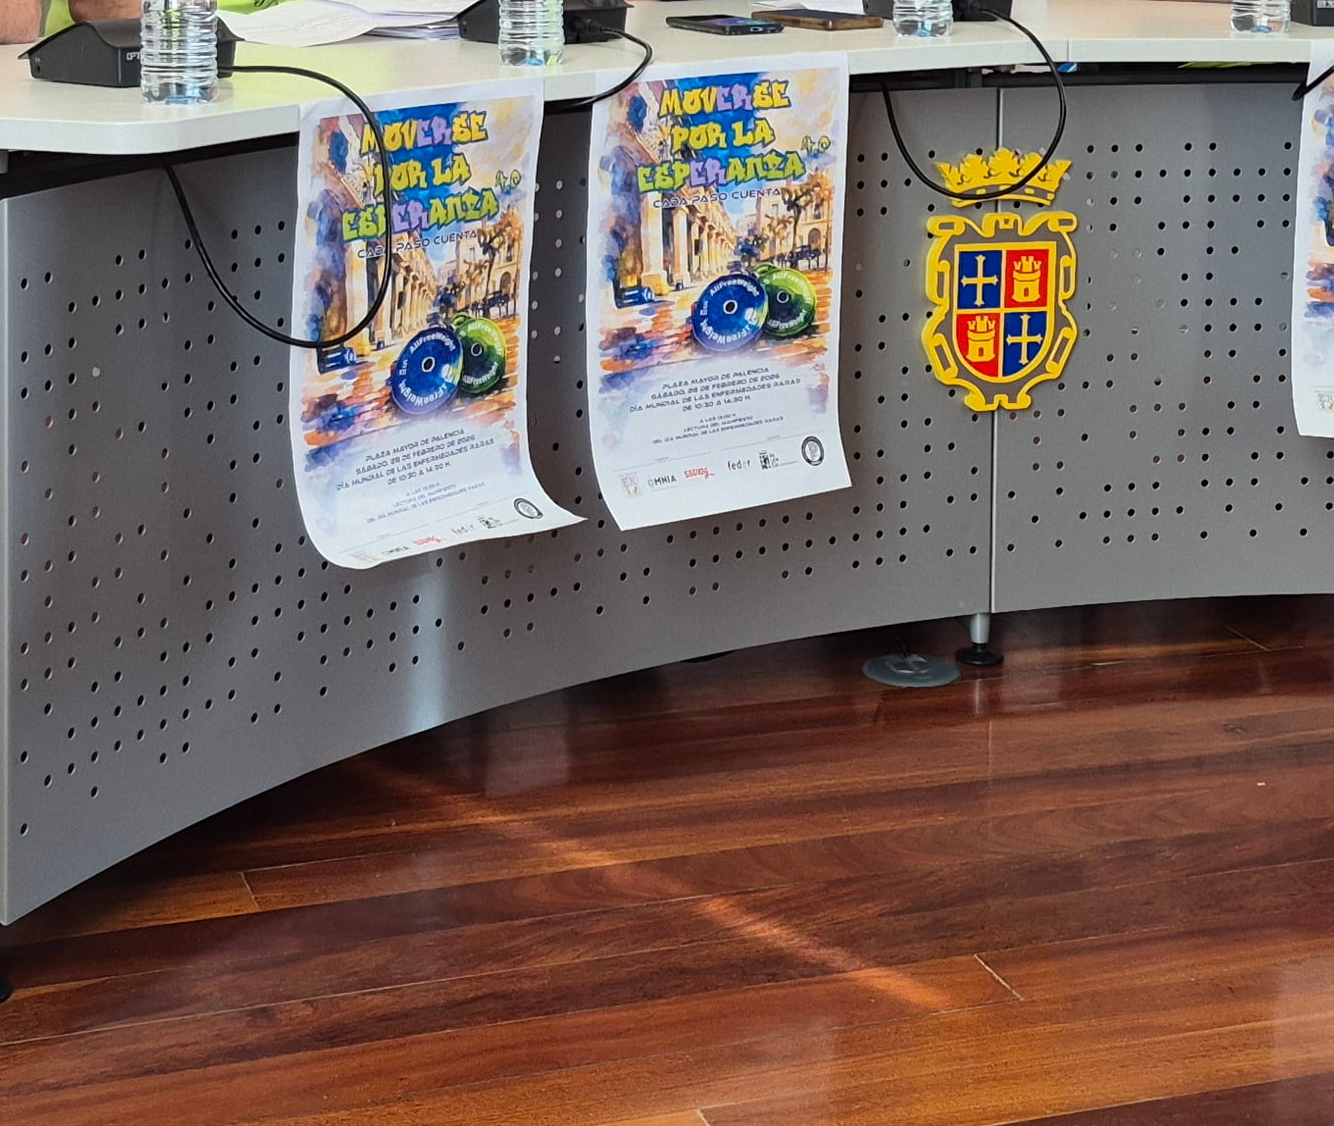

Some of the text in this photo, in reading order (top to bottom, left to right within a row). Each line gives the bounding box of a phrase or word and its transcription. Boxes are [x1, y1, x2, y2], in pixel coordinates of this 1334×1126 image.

[658, 79, 791, 118] MOVERSE
[671, 118, 776, 155] POR LA
[431, 153, 472, 186] LA
[636, 149, 807, 193] ESPERANZA
[653, 188, 780, 209] CADA PASO CUENTA
[396, 238, 429, 252] PASO
[434, 230, 477, 245] CUENTA
